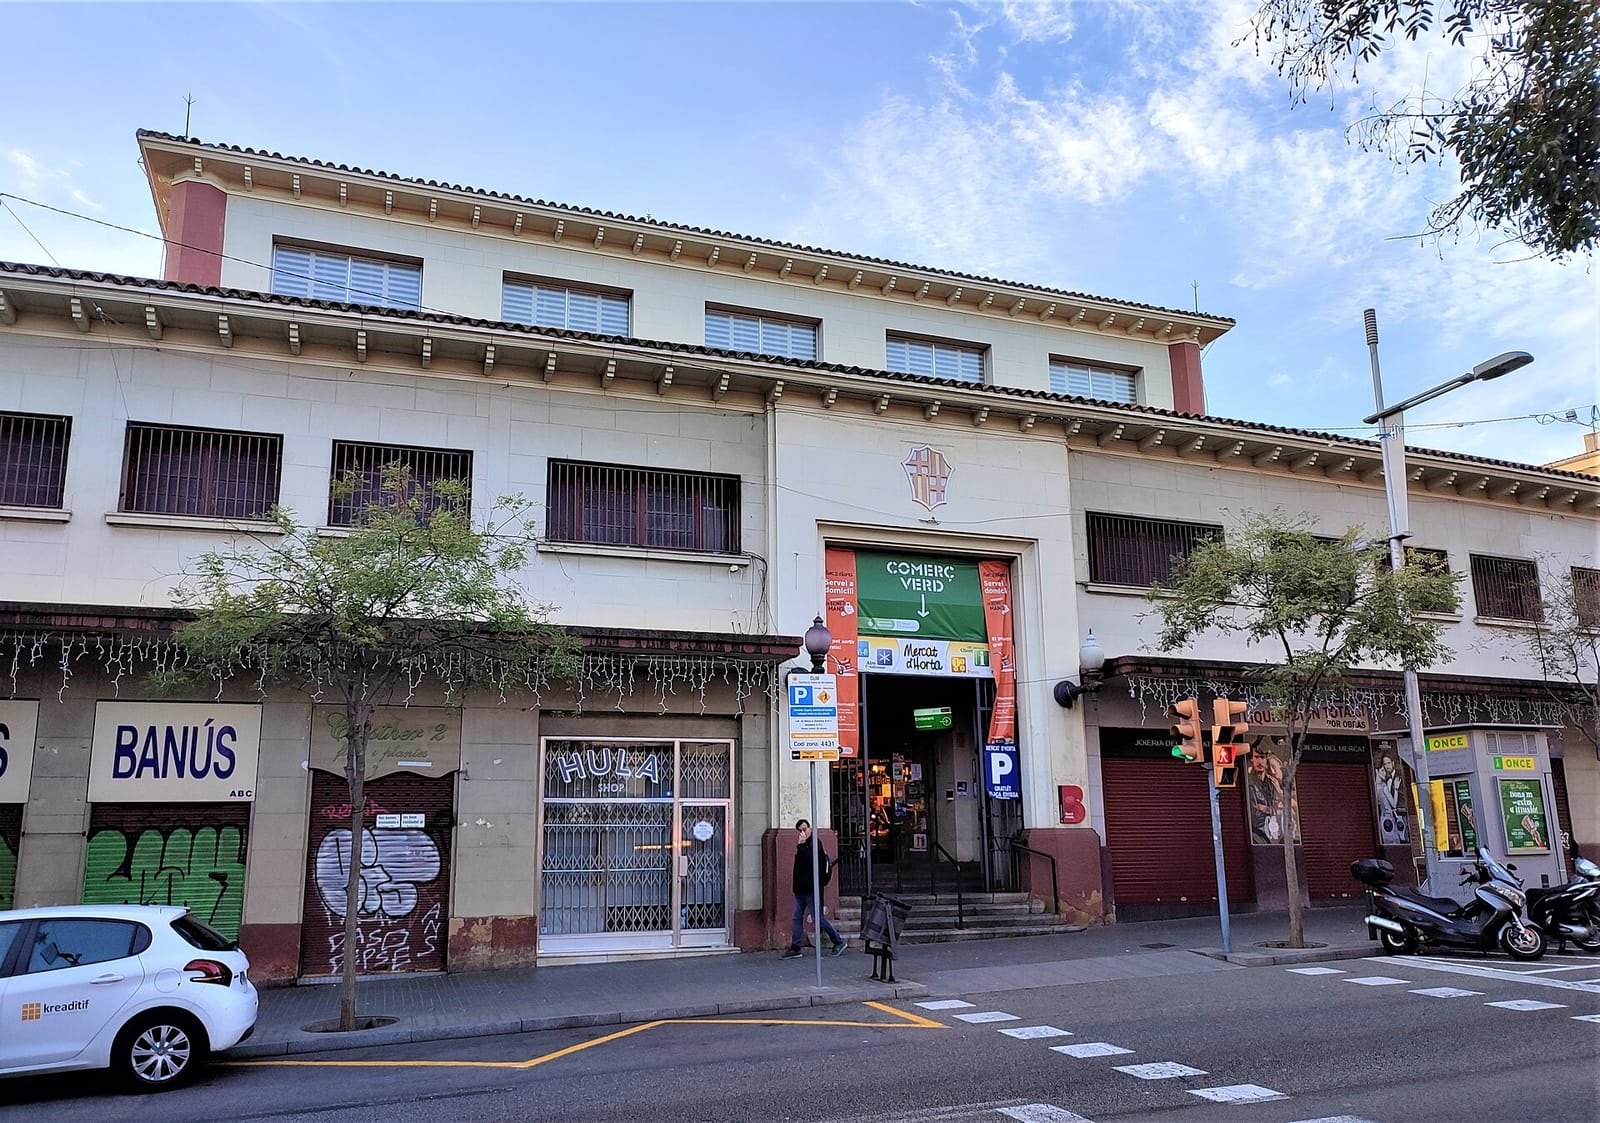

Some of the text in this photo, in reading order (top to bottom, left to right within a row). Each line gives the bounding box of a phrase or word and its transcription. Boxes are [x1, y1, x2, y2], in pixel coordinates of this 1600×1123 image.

[886, 560, 956, 582] COMERÇ
[900, 577, 945, 593] VERD
[904, 643, 938, 657] Mercat
[906, 658, 943, 670] d'Horta
[794, 687, 808, 705] P
[430, 723, 448, 741] 2
[112, 718, 237, 779] BANÚS
[1339, 745, 1366, 753] MERCAT
[1433, 736, 1464, 749] ONCE
[558, 747, 660, 785] HULA
[990, 752, 1013, 785] P
[1505, 758, 1532, 769] ONCE
[229, 789, 253, 798] ABC
[597, 782, 626, 793] SHOP
[43, 999, 89, 1014] kreaditif
